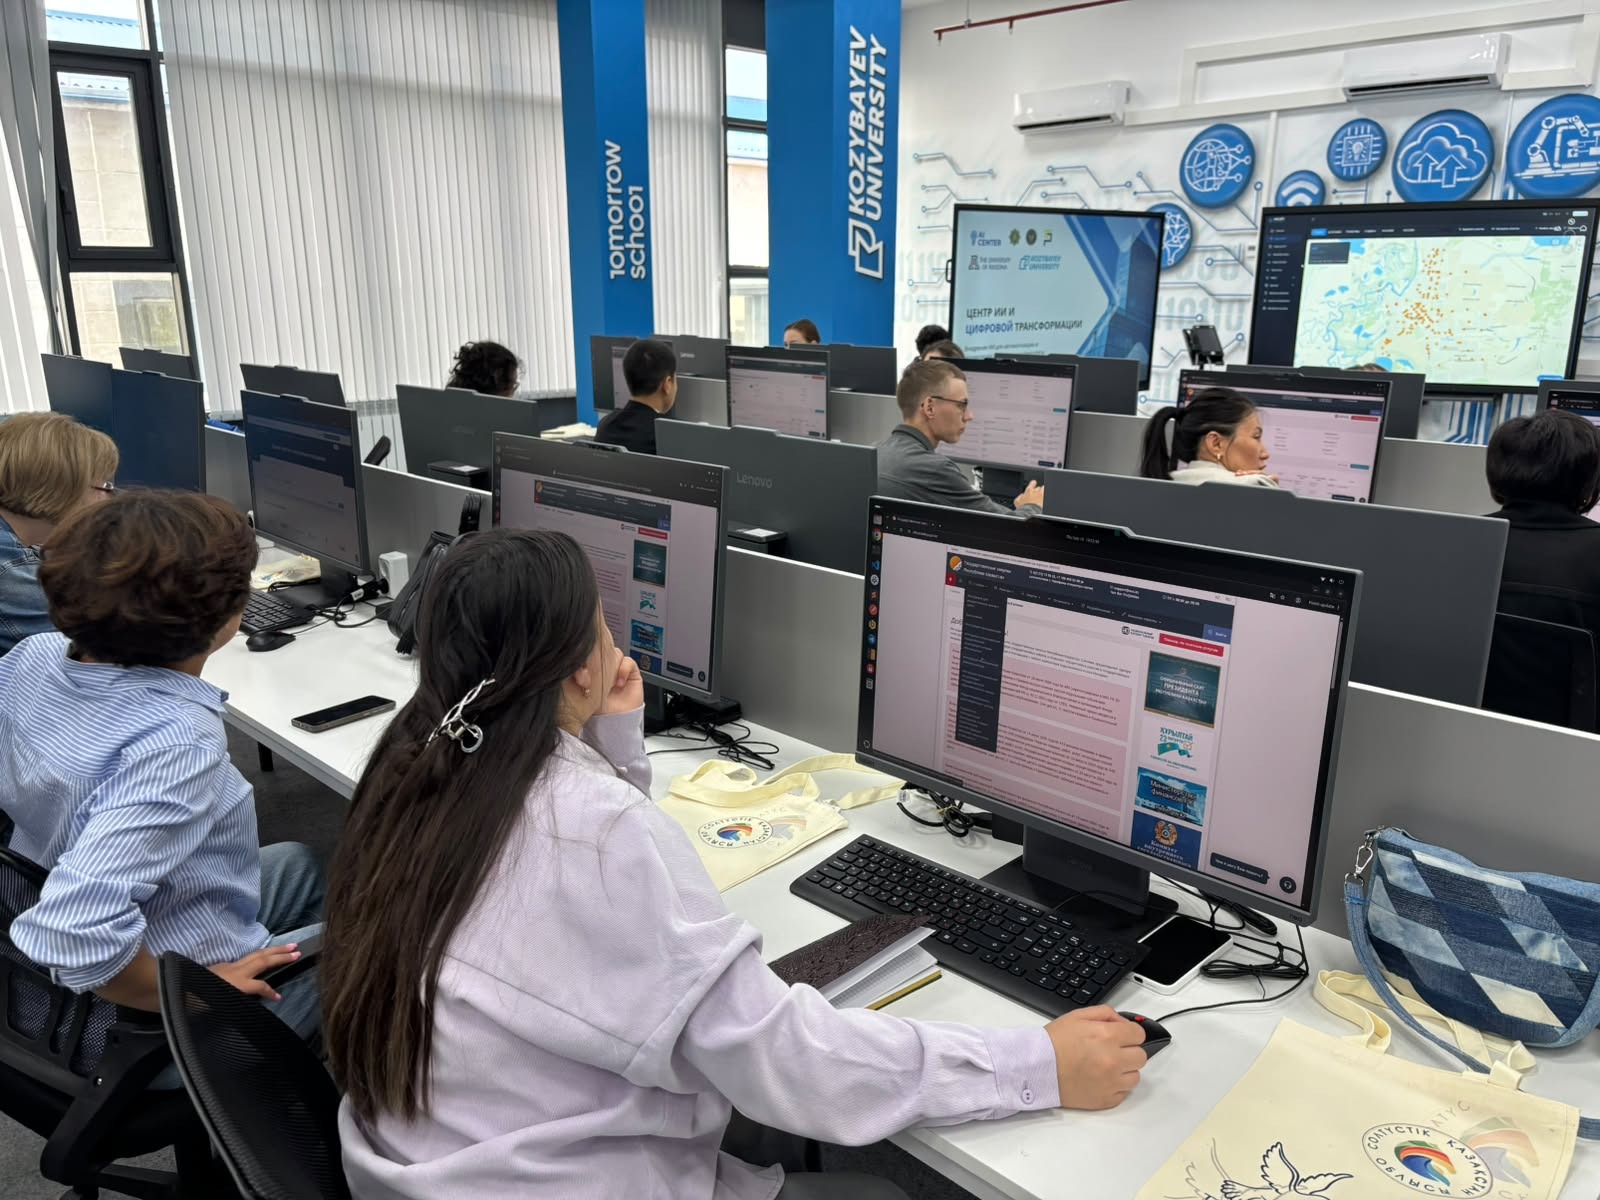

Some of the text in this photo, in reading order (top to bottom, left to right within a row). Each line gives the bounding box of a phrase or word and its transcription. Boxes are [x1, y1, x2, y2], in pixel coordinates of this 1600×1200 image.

[848, 25, 868, 215] KOZYBAYEV
[866, 34, 888, 221] UNIVERSITY
[977, 239, 1002, 247] CENTER
[966, 307, 1015, 320] ЦЕНТР ИИ И
[965, 320, 1083, 336] ЦИФРОВОЙ ТРАНСФОРМАЦИИ
[736, 471, 773, 489] Lenovo
